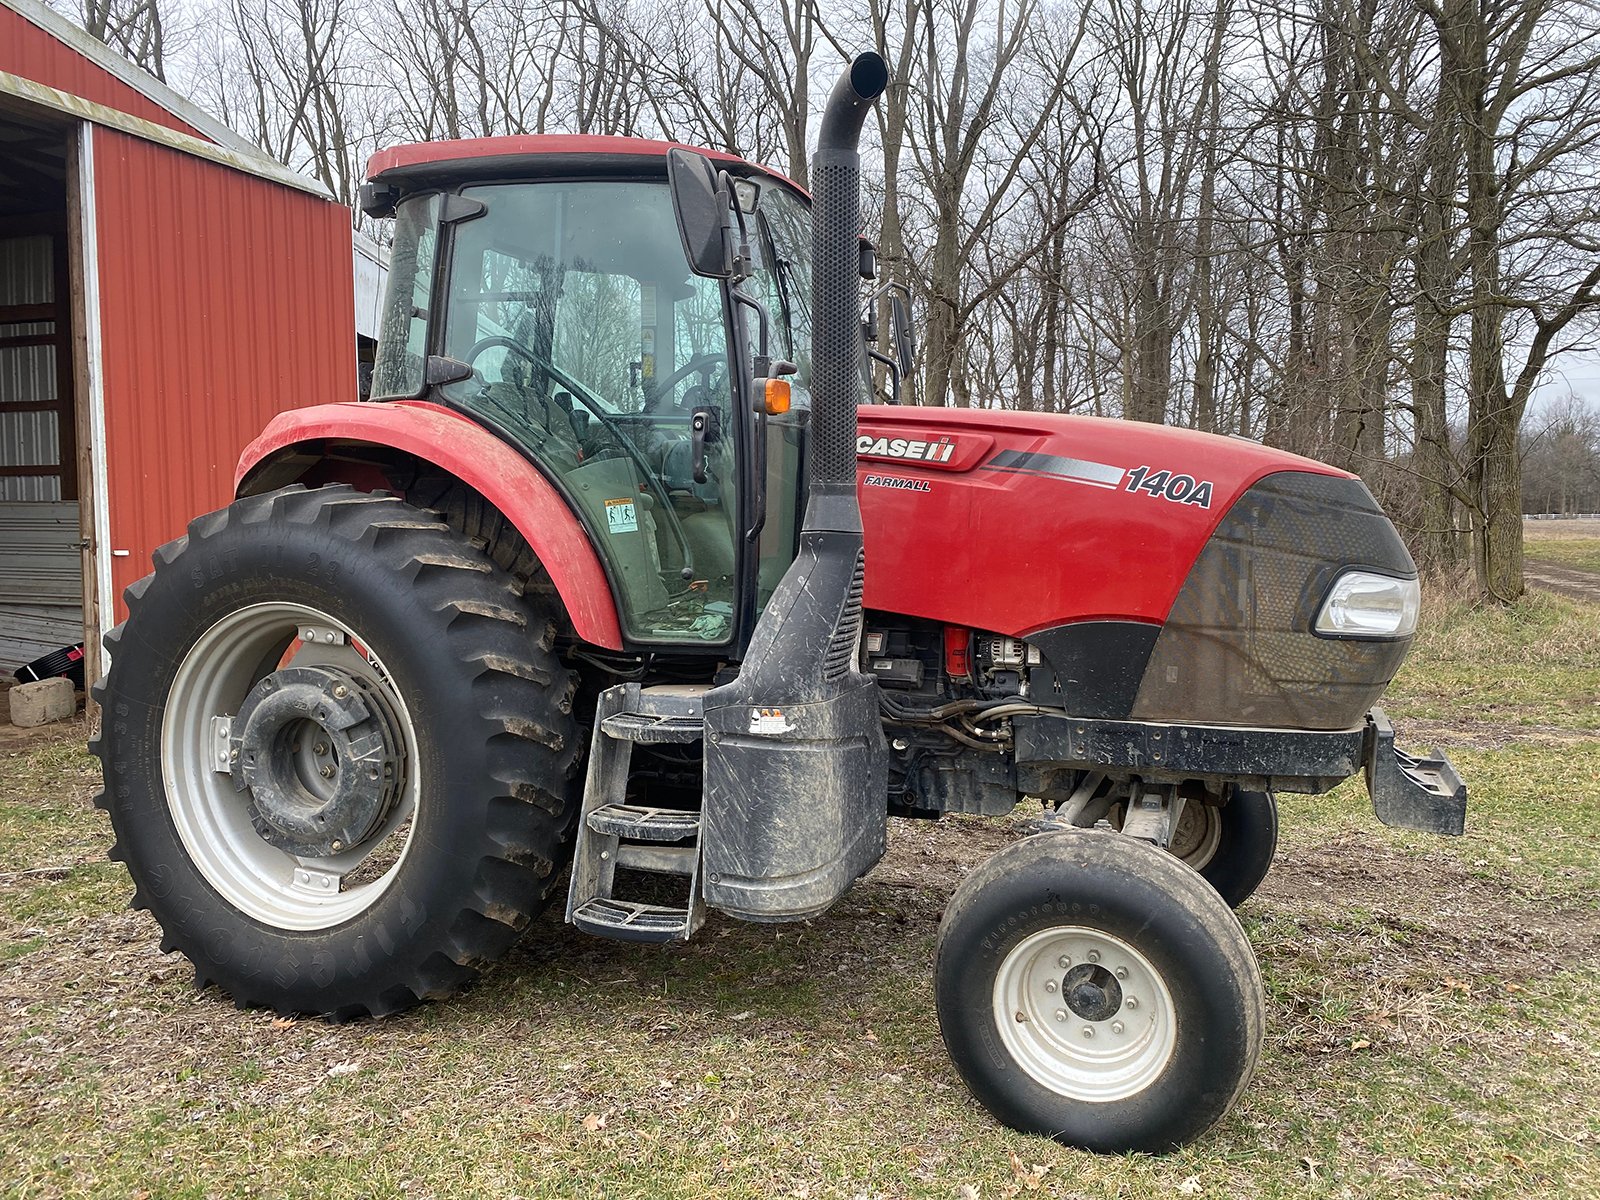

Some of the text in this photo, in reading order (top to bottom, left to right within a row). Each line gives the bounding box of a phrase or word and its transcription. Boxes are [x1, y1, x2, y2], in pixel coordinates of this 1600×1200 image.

[856, 436, 927, 460] CASE
[864, 475, 931, 493] FARMALL
[1125, 465, 1214, 510] 140A
